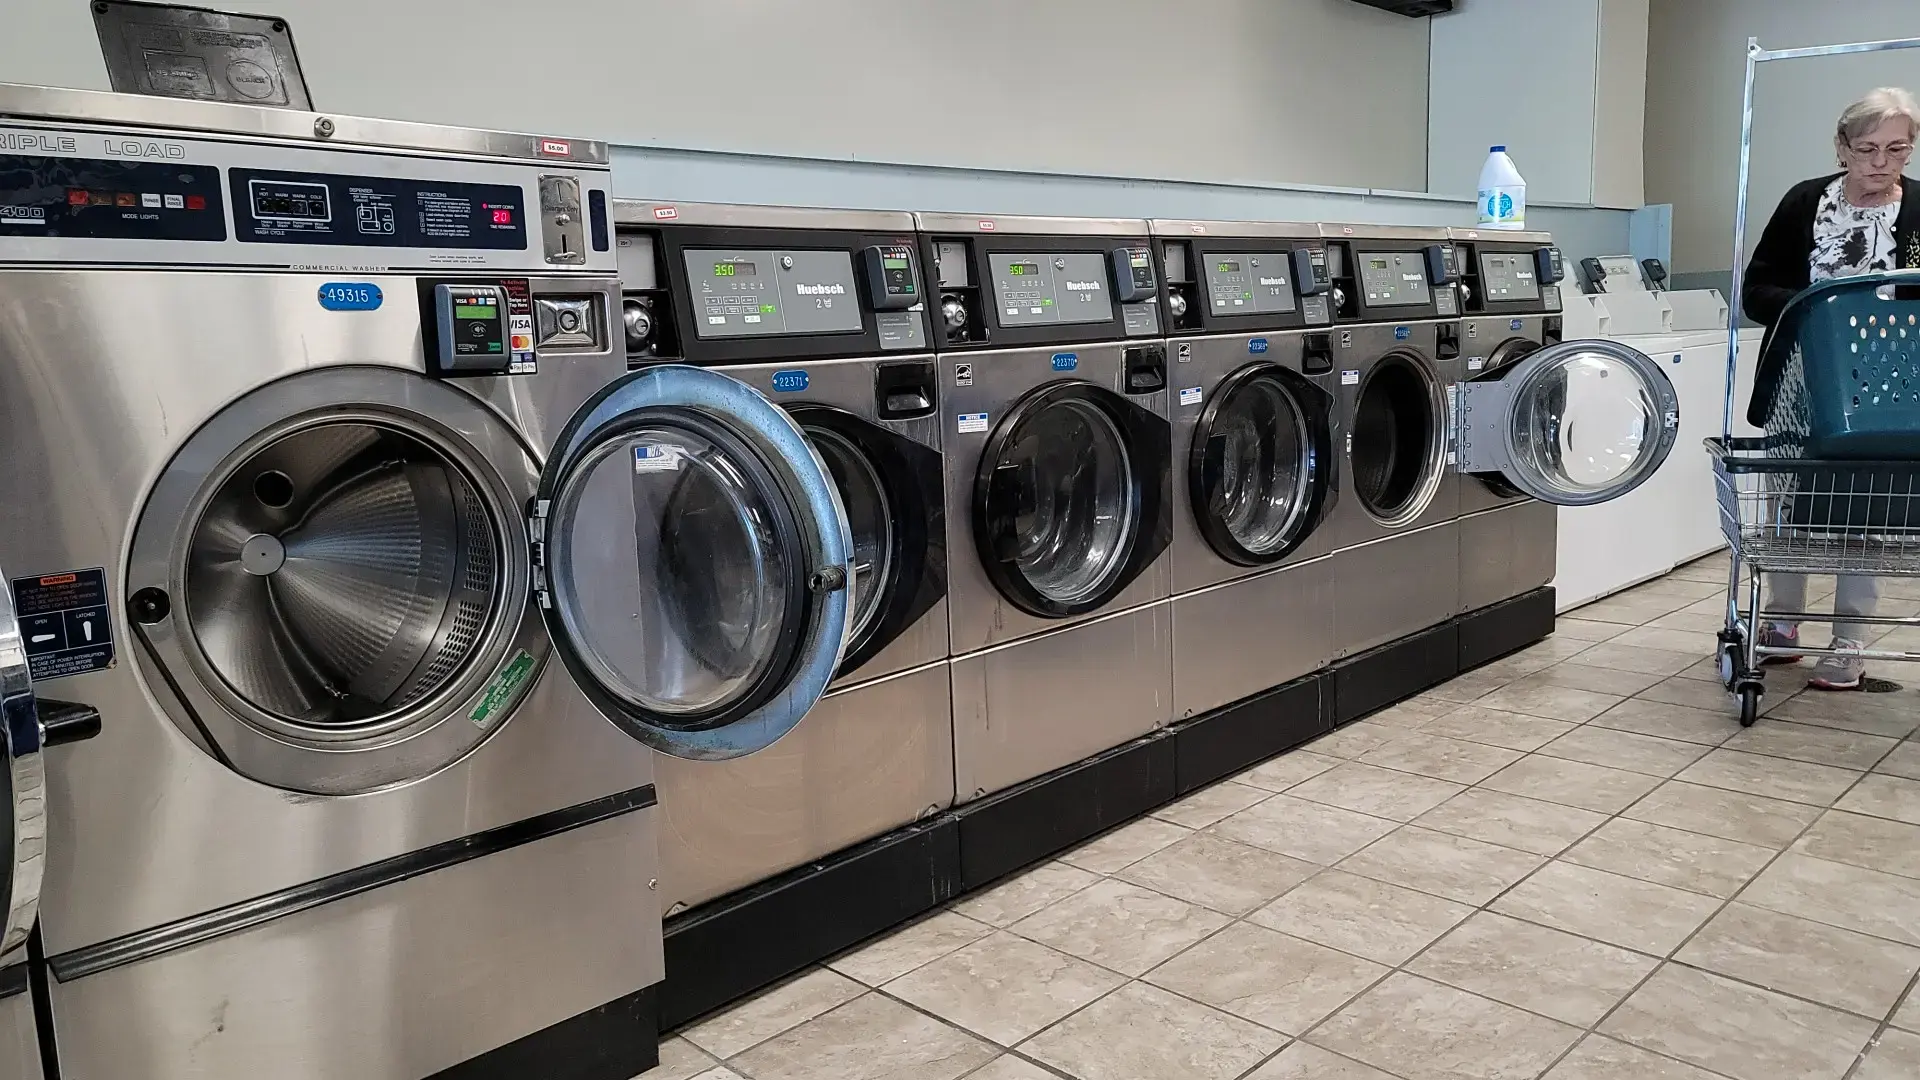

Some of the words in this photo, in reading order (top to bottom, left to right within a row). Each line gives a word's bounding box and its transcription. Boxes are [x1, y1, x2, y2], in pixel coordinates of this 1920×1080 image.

[104, 140, 186, 160] LOAD
[494, 212, 507, 222] 20
[715, 264, 734, 276] 3.50
[796, 283, 845, 296] Huebsch
[1066, 281, 1100, 291] Huebsch
[328, 288, 370, 304] 49315
[816, 298, 822, 308] 2
[511, 320, 530, 328] VISA
[779, 376, 804, 388] 22371
[42, 576, 74, 584] WARNING
[32, 669, 60, 677] ATTEMPTING
